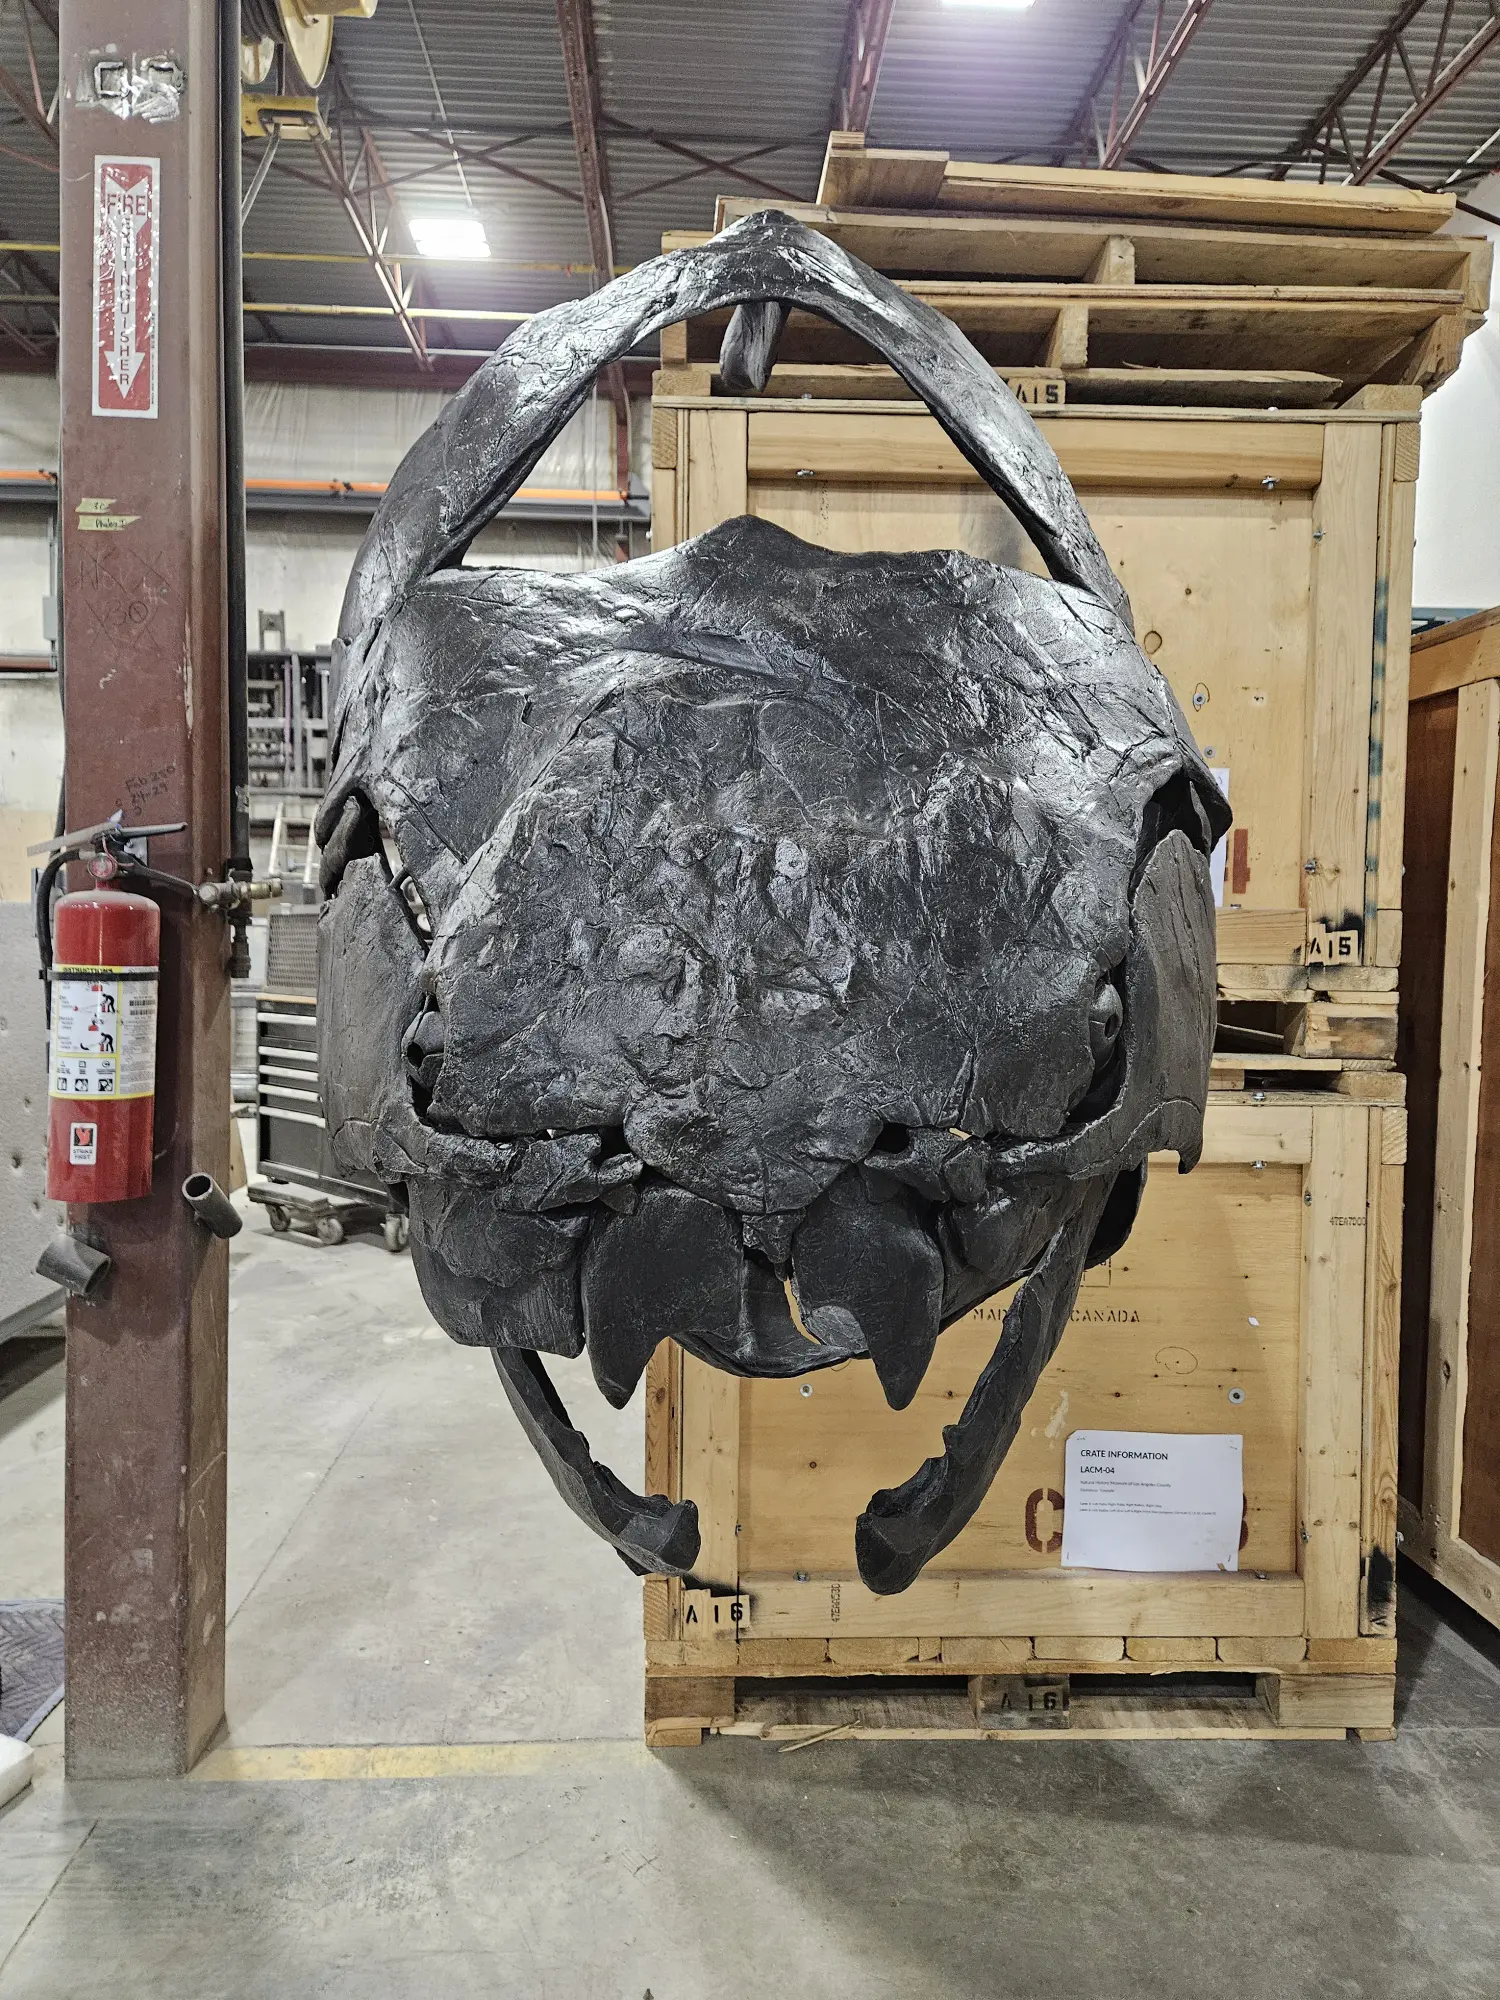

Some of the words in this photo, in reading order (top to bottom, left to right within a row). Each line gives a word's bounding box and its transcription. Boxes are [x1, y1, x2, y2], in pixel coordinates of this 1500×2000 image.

[107, 193, 146, 216] FIRE
[1015, 383, 1059, 404] A15
[1310, 937, 1351, 959] A15
[973, 1308, 1007, 1322] MAD
[1070, 1309, 1140, 1323] CANADA
[1080, 1449, 1106, 1458] CRATE
[1108, 1450, 1169, 1460] INFORMATION
[1080, 1466, 1115, 1474] LACM-04
[685, 1602, 743, 1625] A16
[1001, 1692, 1057, 1711] A16
